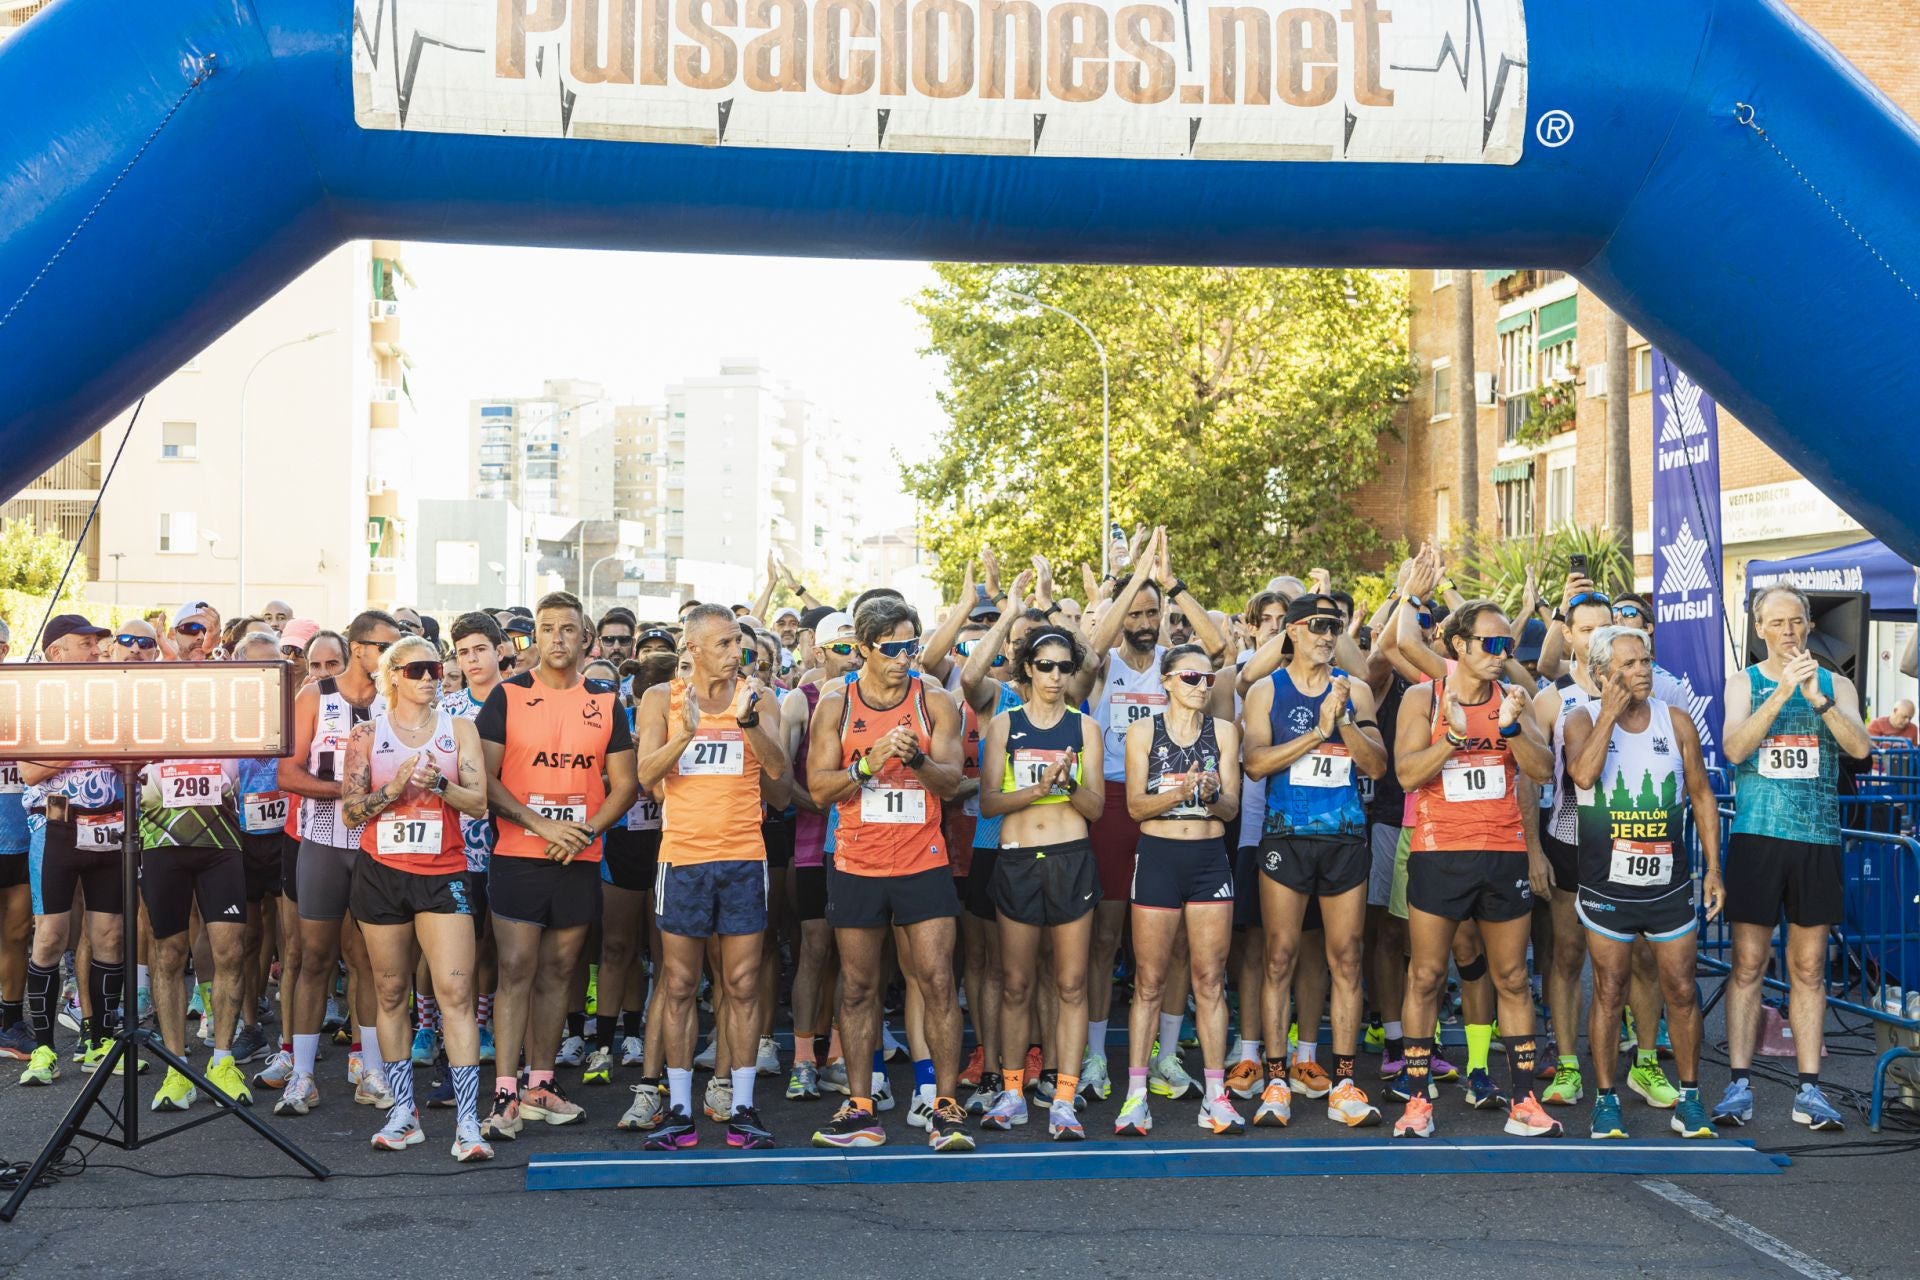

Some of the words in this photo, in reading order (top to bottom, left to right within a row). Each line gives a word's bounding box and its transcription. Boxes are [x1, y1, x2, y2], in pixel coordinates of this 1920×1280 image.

[1755, 487, 1791, 503] DIRECTA
[531, 752, 596, 769] ASFAS
[694, 743, 728, 764] 277
[1770, 748, 1808, 769] 369
[1311, 757, 1332, 777] 74
[173, 777, 210, 798] 298
[1463, 769, 1486, 791] 10
[258, 801, 287, 821] 142
[884, 791, 903, 813] 11
[1609, 808, 1668, 820] TRIATLÓN
[393, 822, 426, 843] 317
[1610, 822, 1668, 839] JEREZ
[1626, 856, 1661, 877] 198
